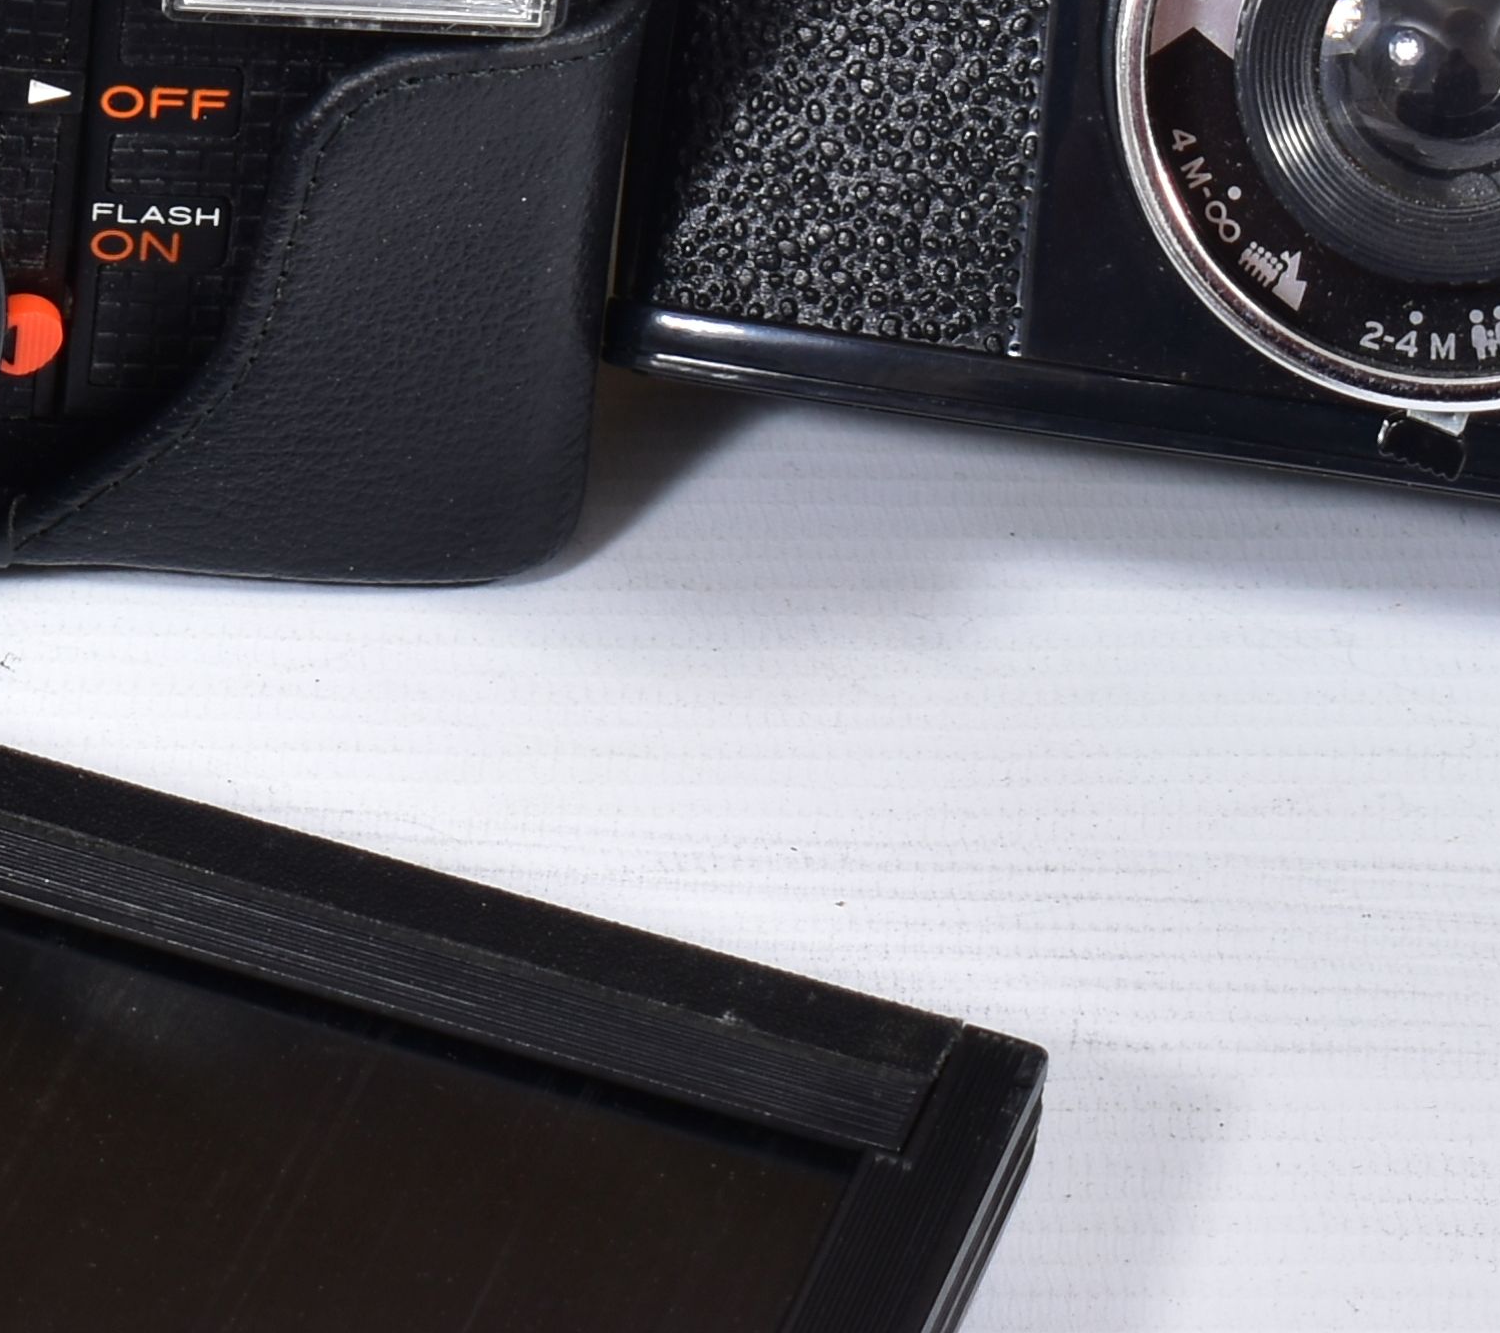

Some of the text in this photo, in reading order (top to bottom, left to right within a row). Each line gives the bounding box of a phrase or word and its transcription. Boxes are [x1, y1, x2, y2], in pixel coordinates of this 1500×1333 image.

[100, 84, 231, 121] OFF
[1169, 126, 1194, 154] 4
[91, 201, 222, 227] FLASH
[89, 228, 181, 264] ON
[1358, 319, 1457, 361] 2-4 M
